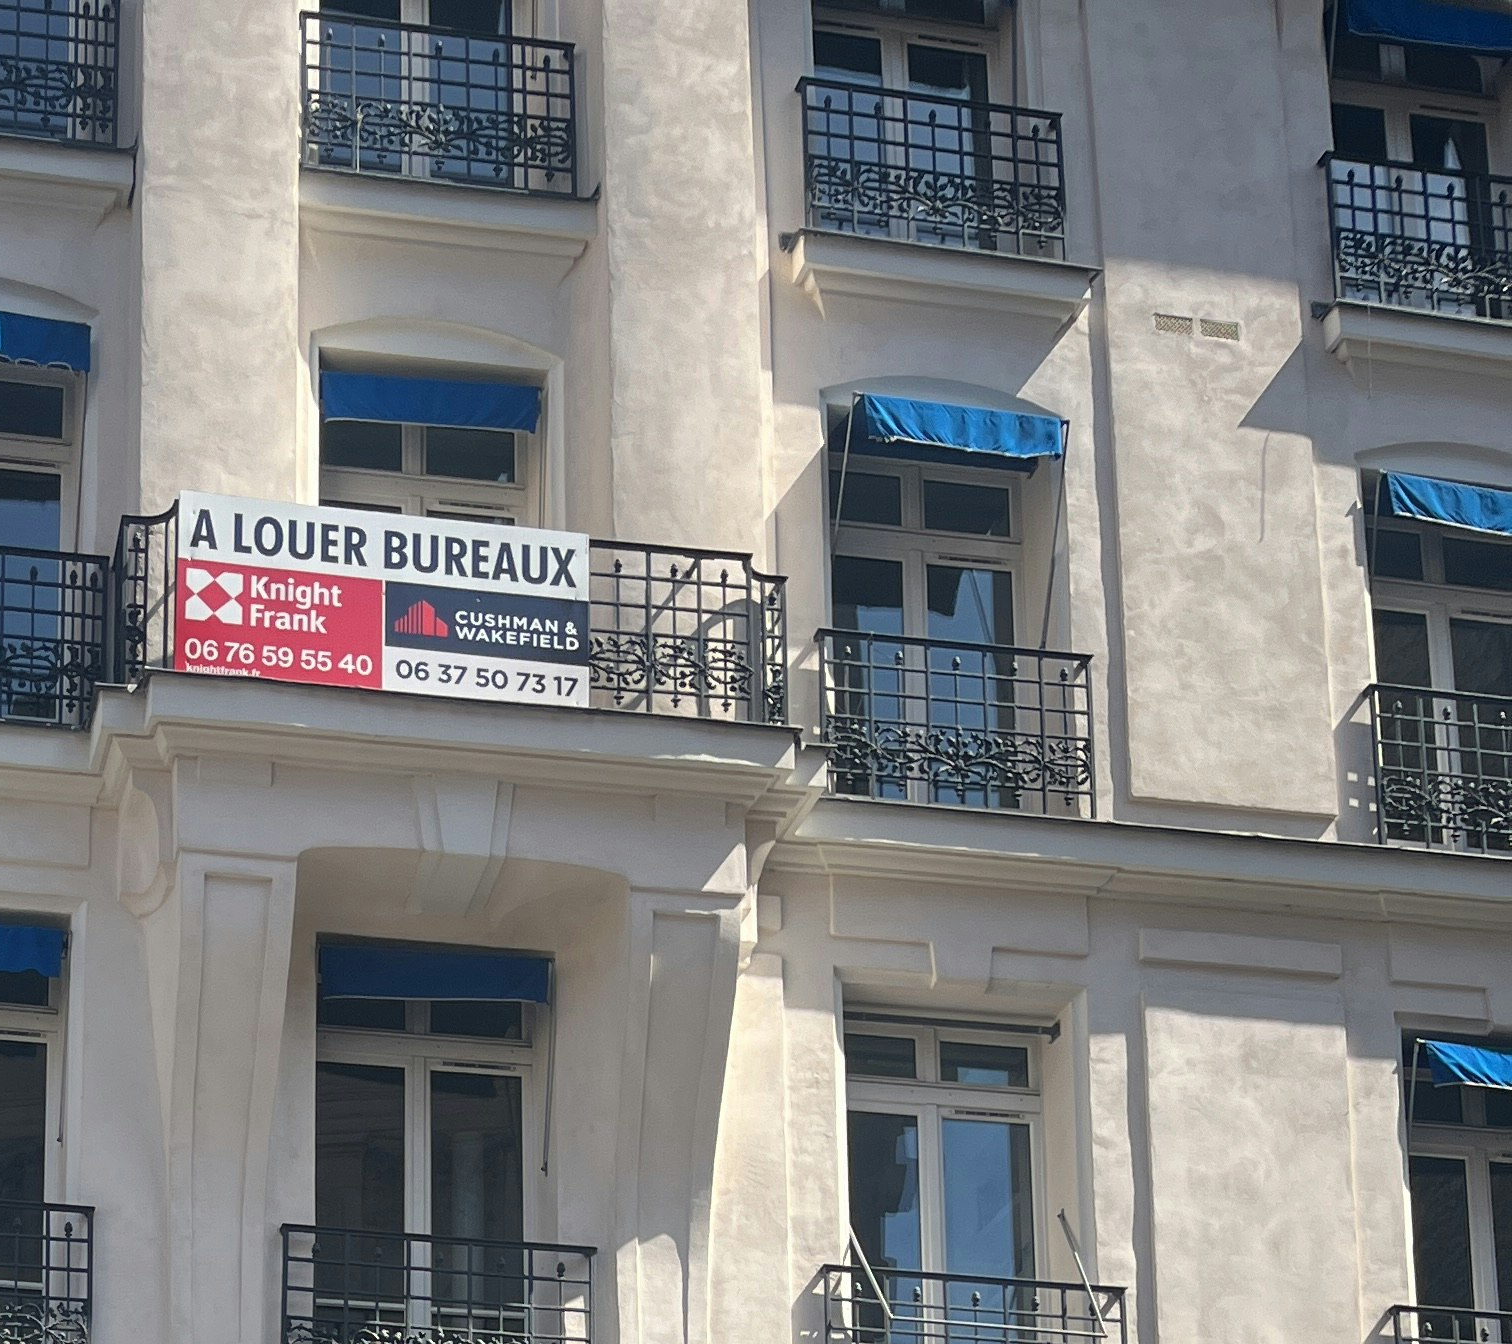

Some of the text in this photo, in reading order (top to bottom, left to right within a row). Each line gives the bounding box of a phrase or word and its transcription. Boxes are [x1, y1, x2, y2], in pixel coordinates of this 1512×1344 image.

[190, 508, 577, 588] A LOUER BUREAUX
[250, 574, 343, 610] Knight
[250, 603, 328, 635] Frank
[454, 610, 578, 636] CUSHMAN &
[454, 624, 580, 651] WAKEFIELD
[184, 637, 373, 676] 06 76 59 55 40
[395, 659, 579, 697] 06 37 50 73 17
